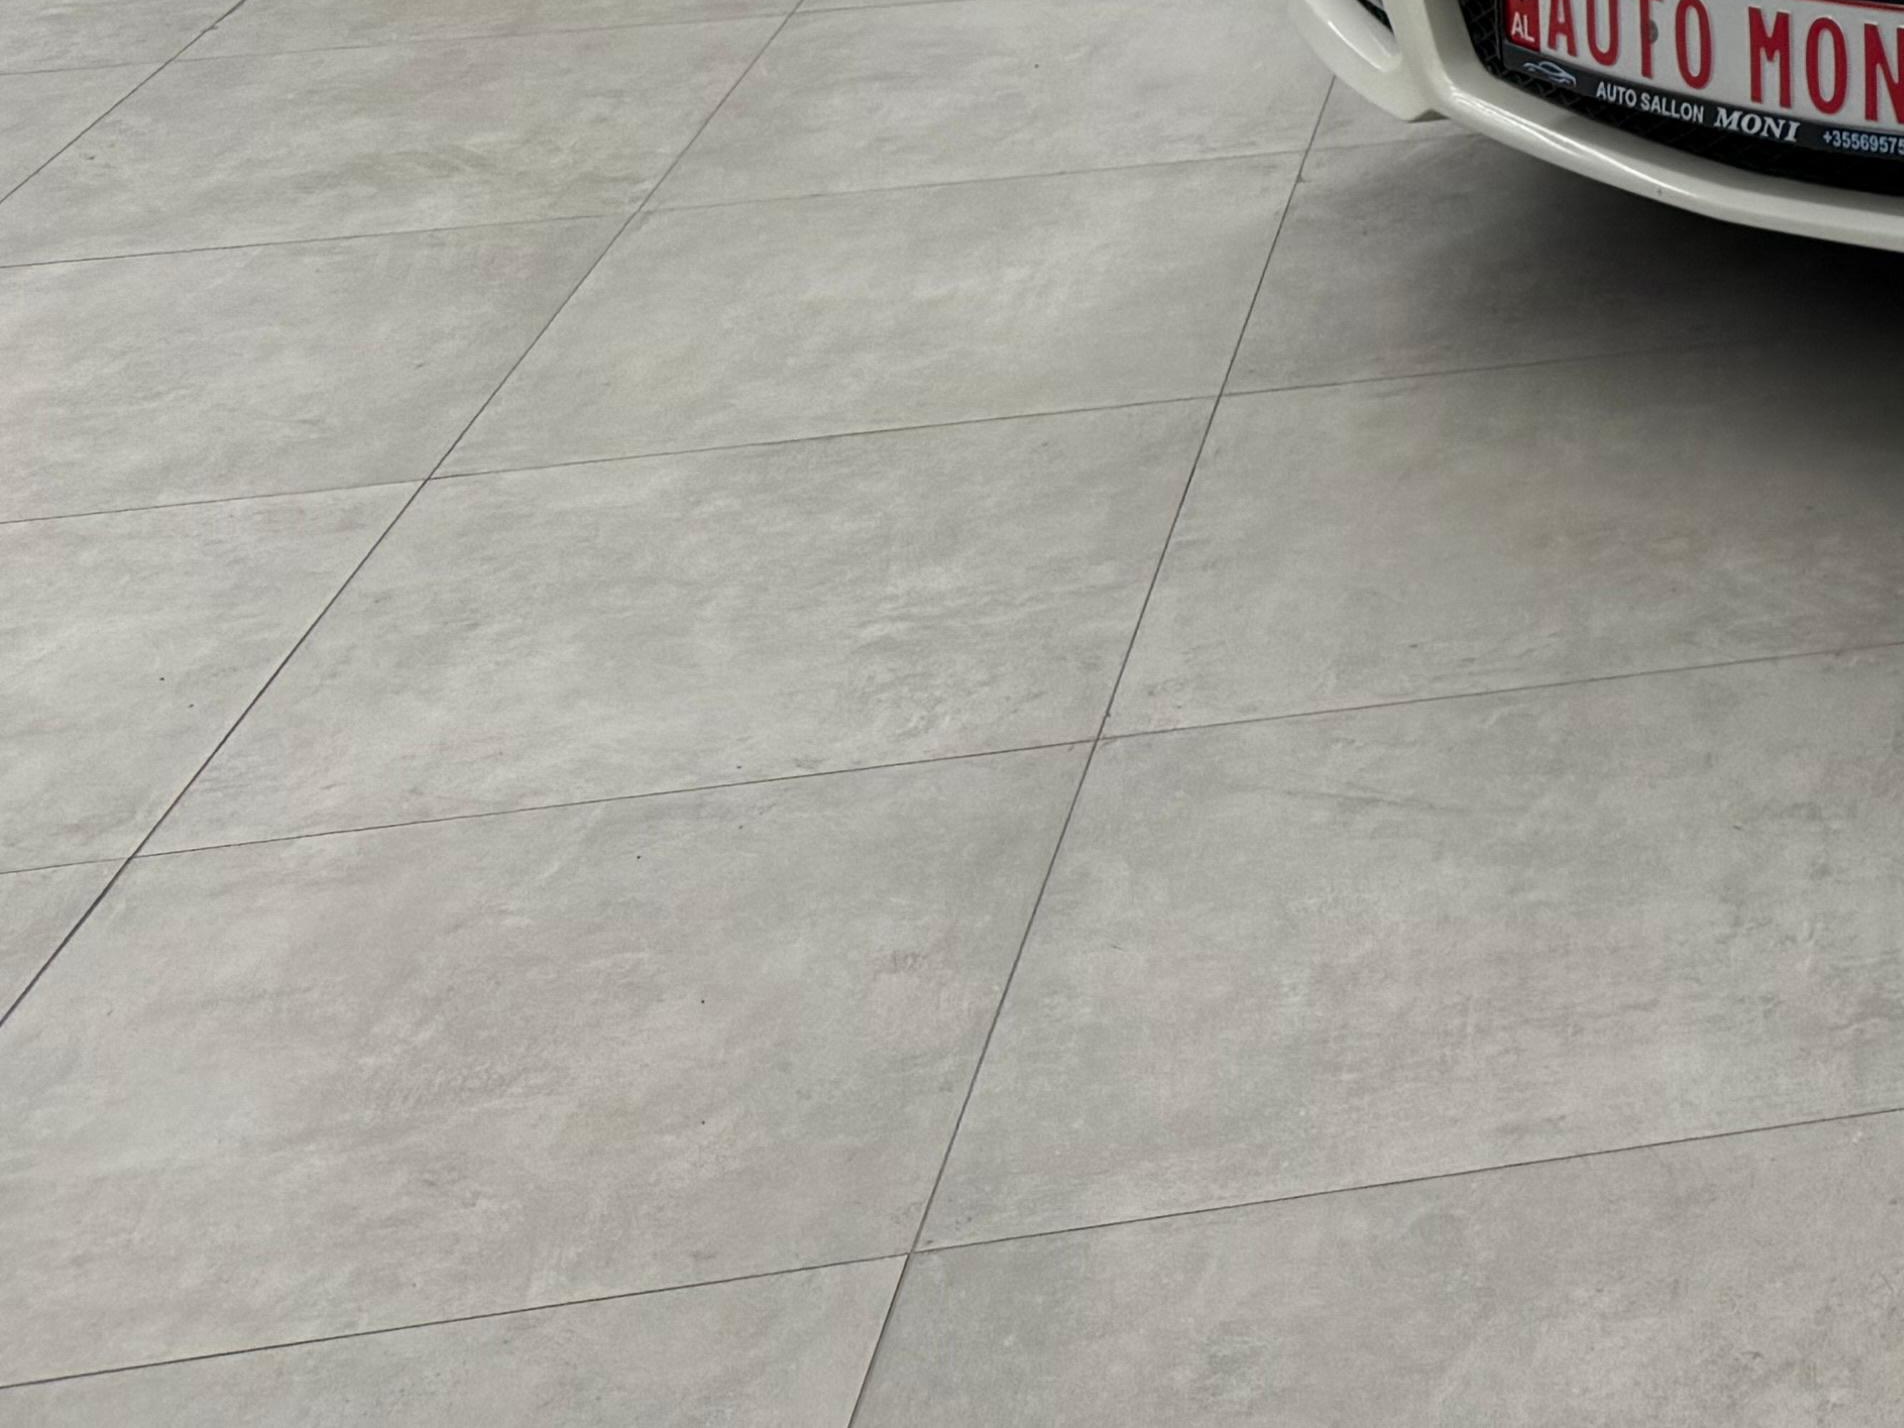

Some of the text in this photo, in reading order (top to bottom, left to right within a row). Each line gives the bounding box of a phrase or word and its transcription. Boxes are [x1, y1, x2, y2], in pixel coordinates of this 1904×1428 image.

[1510, 11, 1536, 43] AL
[1596, 81, 1637, 107] AUTO
[1640, 92, 1705, 124] SALLON
[1714, 107, 1800, 142] MONI
